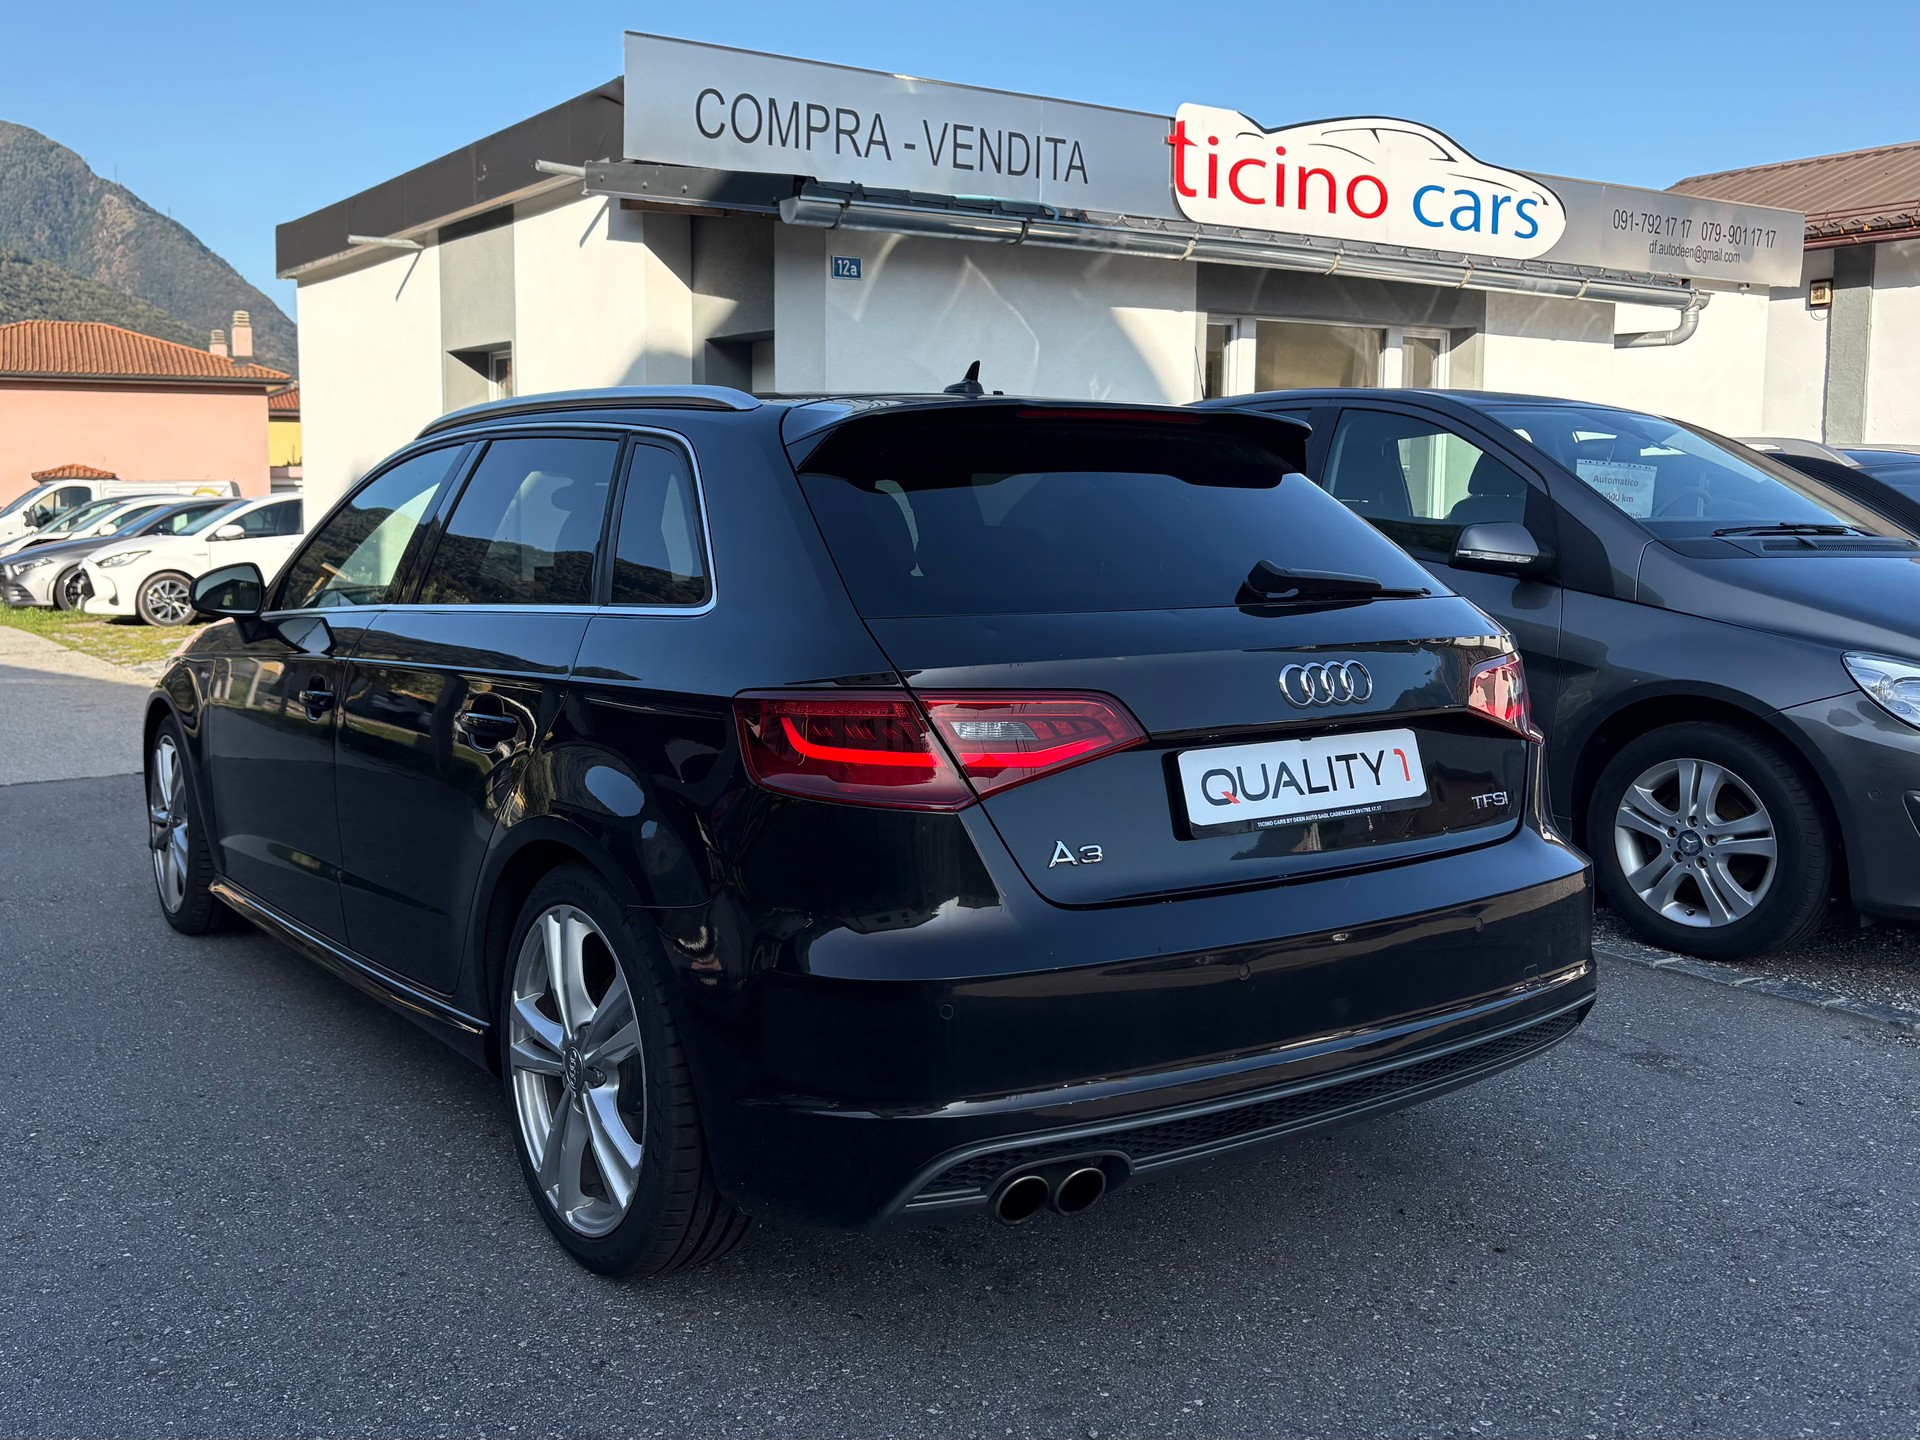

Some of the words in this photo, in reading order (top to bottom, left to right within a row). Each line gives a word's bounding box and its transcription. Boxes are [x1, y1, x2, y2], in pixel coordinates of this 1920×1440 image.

[695, 87, 892, 162] COMPRA
[1168, 120, 1389, 219] ticino
[1412, 184, 1540, 239] cars
[1613, 209, 1662, 235] 091-792
[1665, 216, 1678, 237] 17
[1681, 218, 1693, 239] 17
[1648, 239, 1741, 264] df.autodeen@gmail.com
[837, 259, 858, 276] 12a
[1592, 474, 1639, 487] Automatico
[1621, 494, 1634, 503] km
[1201, 750, 1386, 807] QUALITY
[1393, 748, 1411, 782] 1
[1471, 791, 1509, 810] TFSI
[1257, 820, 1274, 828] TICINO
[1048, 840, 1104, 869] A3
